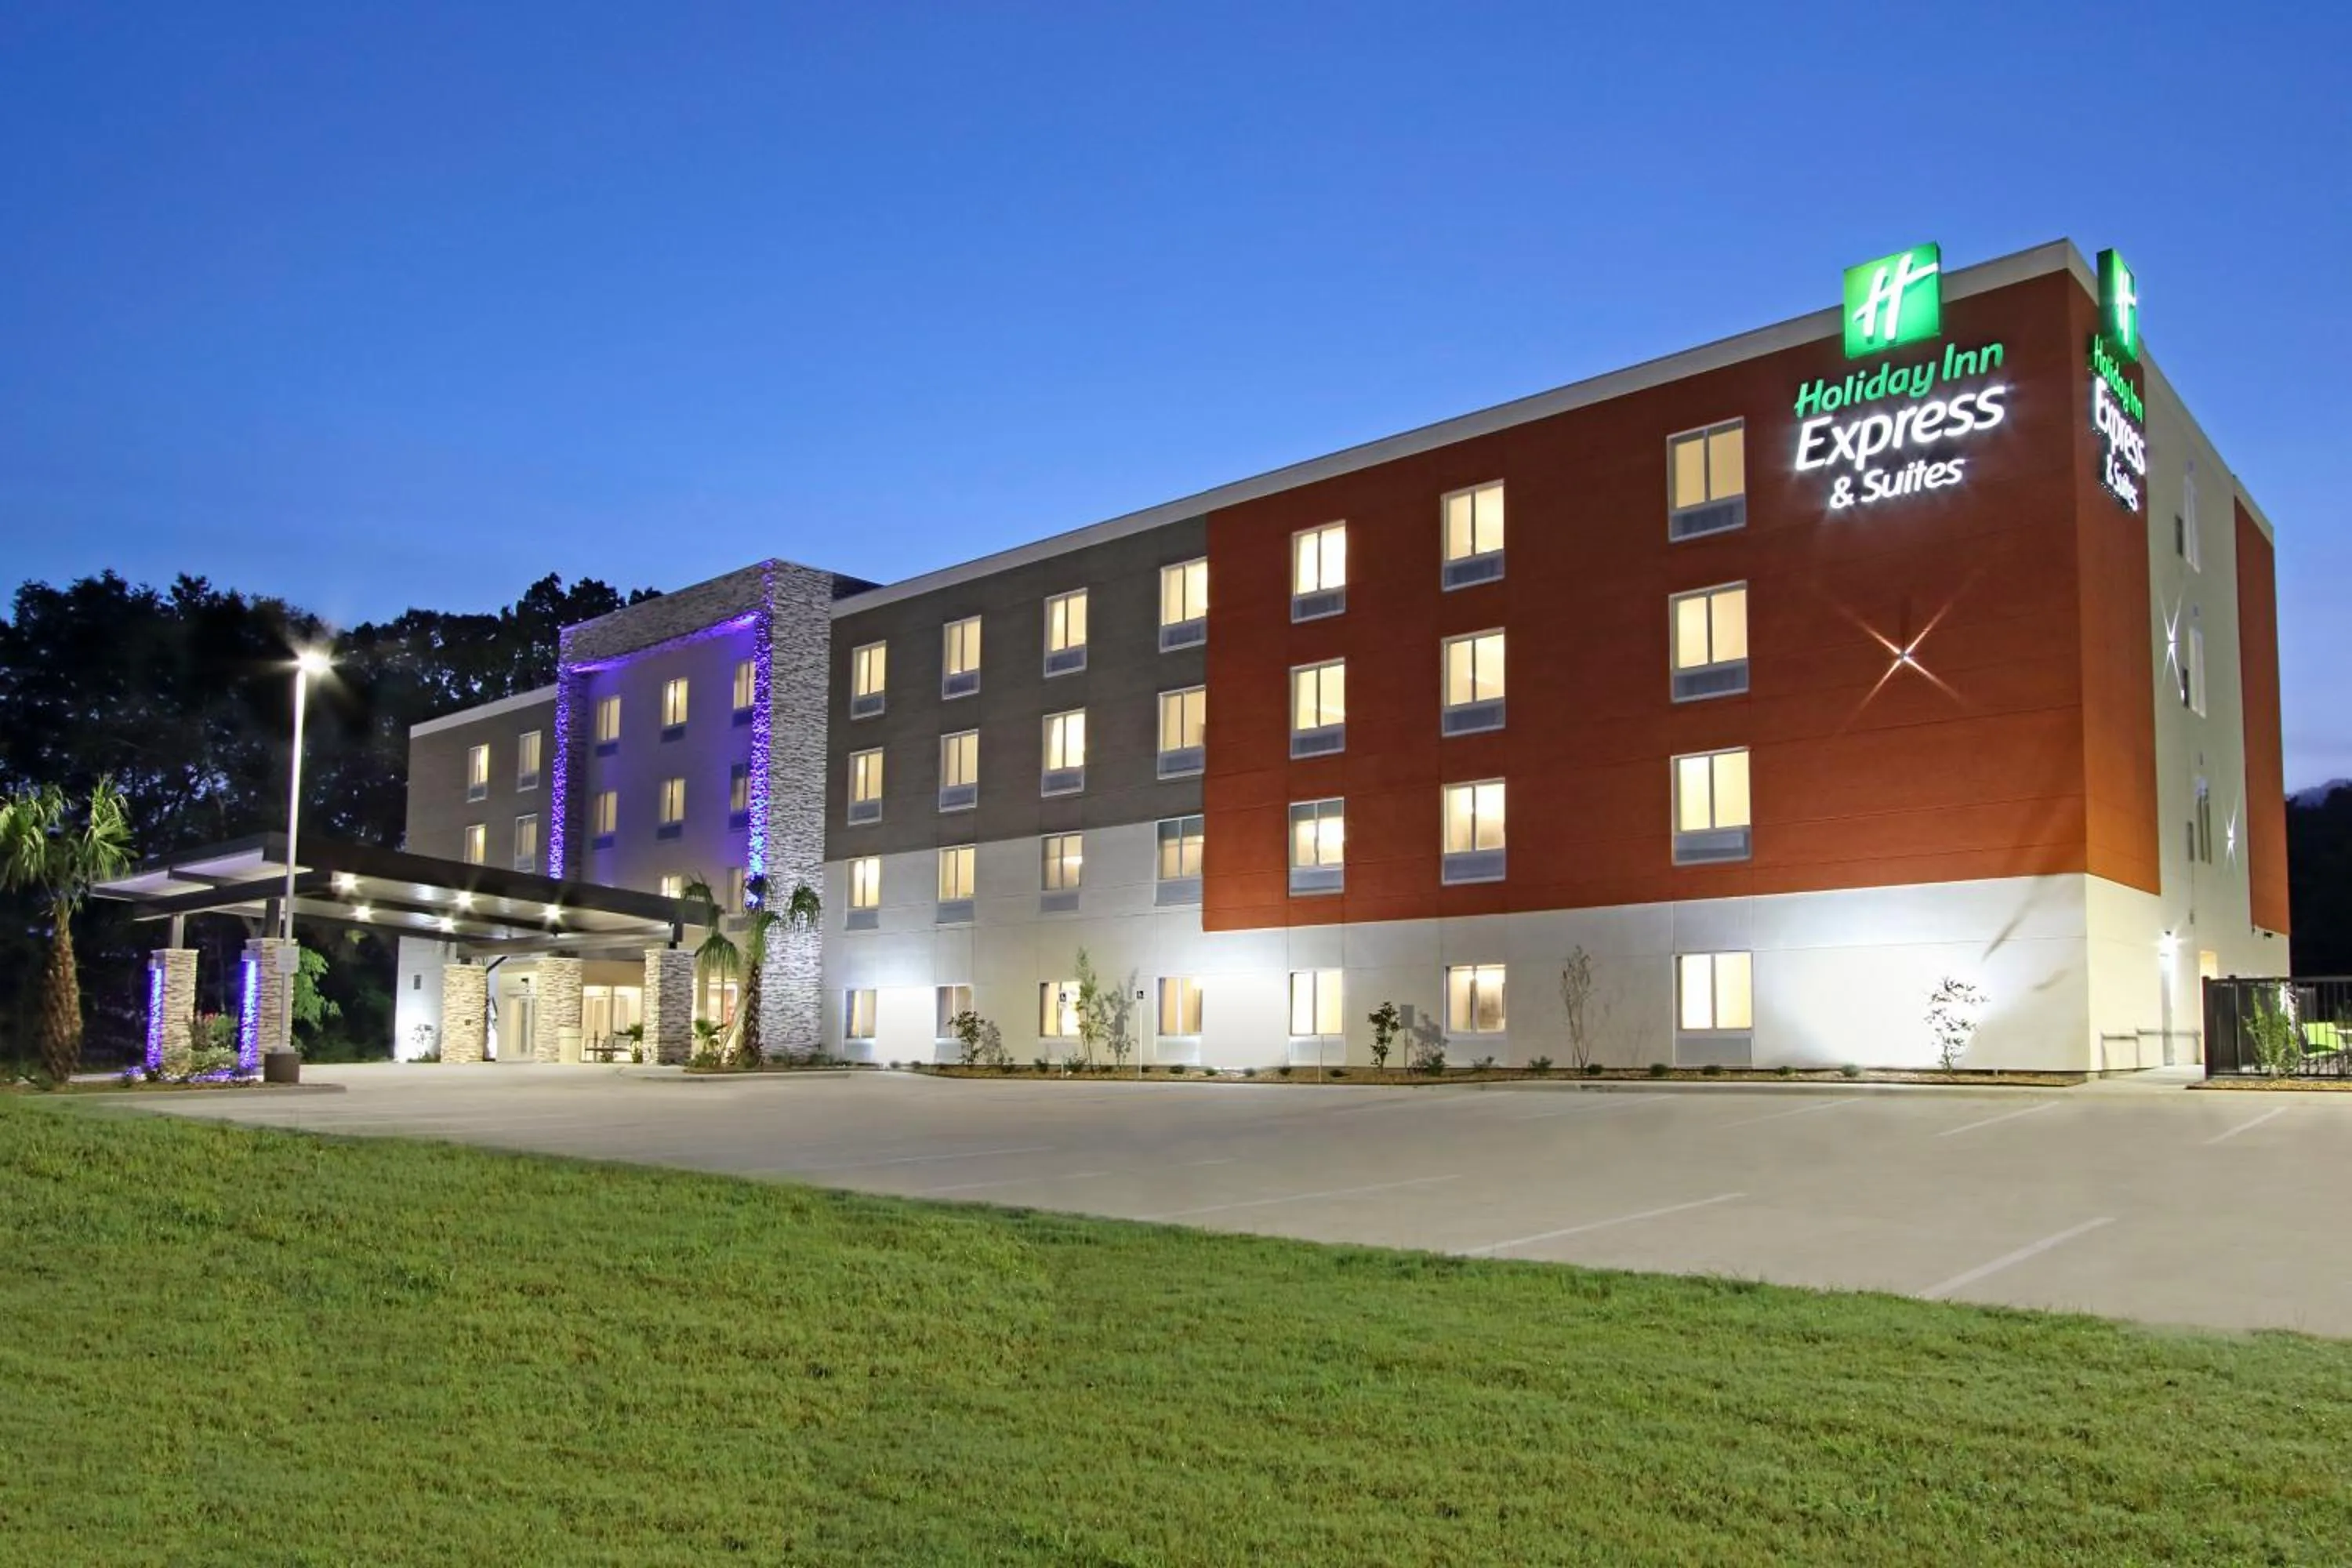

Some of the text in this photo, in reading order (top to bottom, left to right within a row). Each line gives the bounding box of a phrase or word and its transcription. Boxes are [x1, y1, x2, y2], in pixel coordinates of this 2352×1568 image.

[1853, 252, 1938, 340] H
[1795, 343, 2004, 418] Holiday Inn
[2094, 334, 2143, 423] Holiday Inn
[1795, 386, 2006, 470] Express
[2095, 377, 2146, 474] Express
[1829, 459, 1965, 509] & Suites
